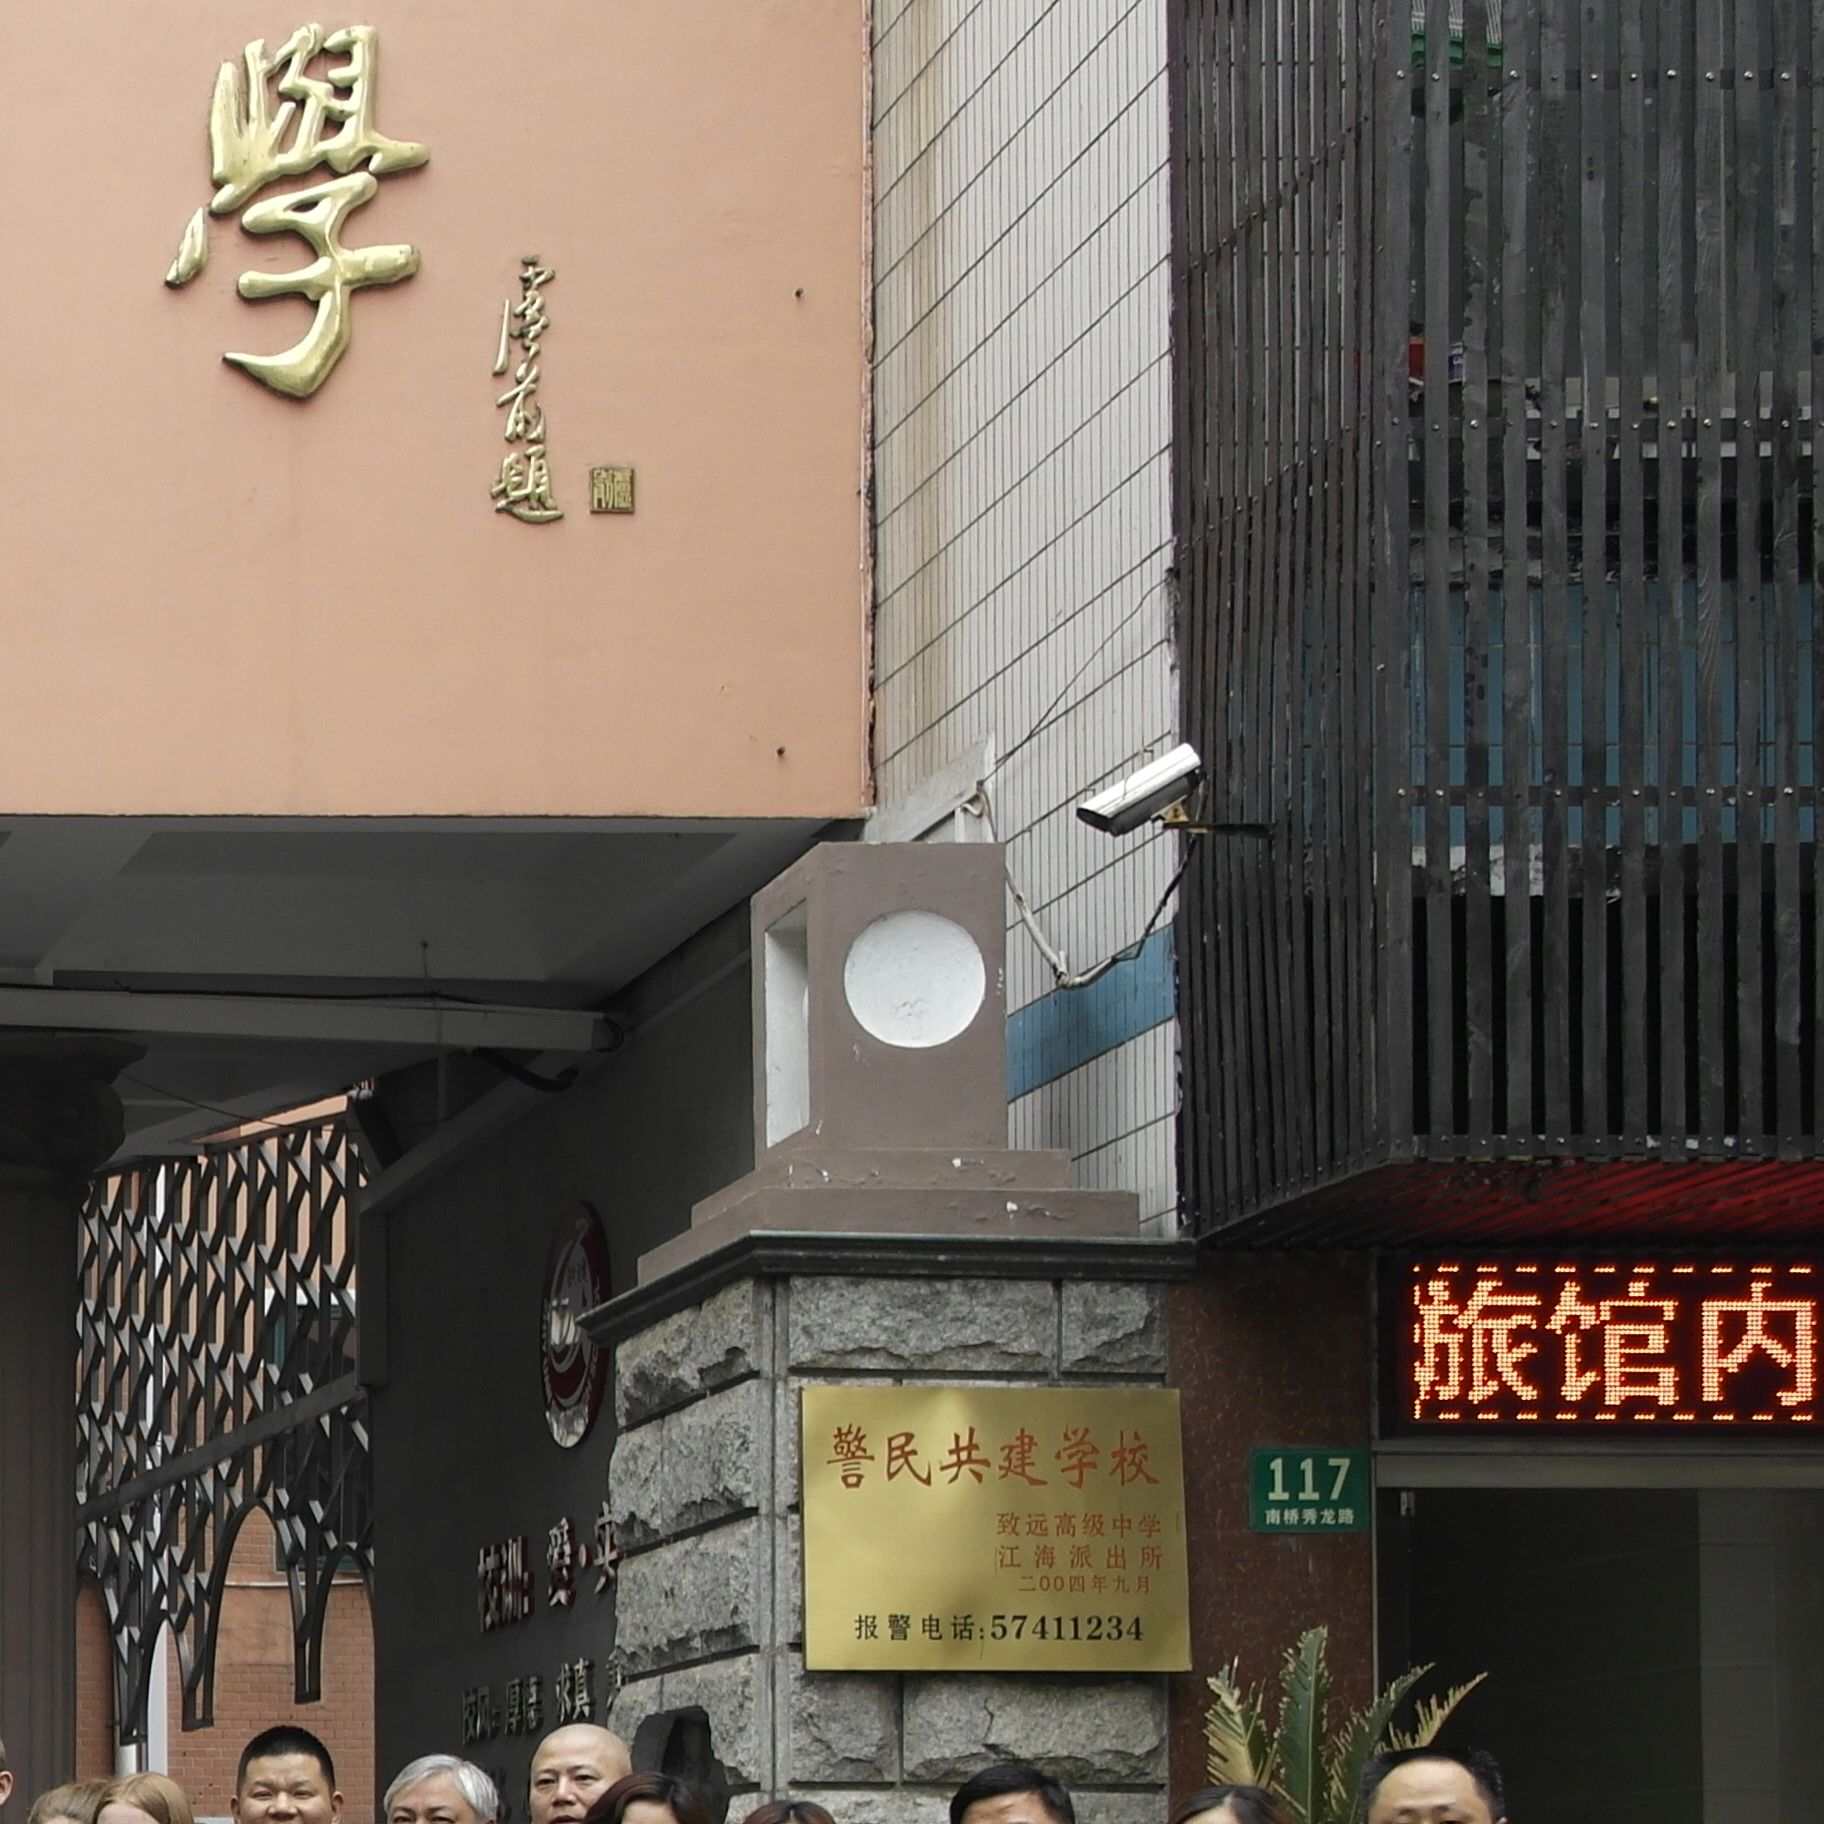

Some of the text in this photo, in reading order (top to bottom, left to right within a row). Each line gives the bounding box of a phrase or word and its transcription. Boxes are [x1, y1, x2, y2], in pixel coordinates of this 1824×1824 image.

[1413, 1279, 1818, 1407] 旅馆内
[826, 1422, 1160, 1490] 警民共建学校
[1267, 1456, 1351, 1502] 117
[996, 1512, 1163, 1538] 致远高级中学
[1264, 1508, 1355, 1526] 南桥秀龙路
[997, 1544, 1164, 1570] 江海派出所
